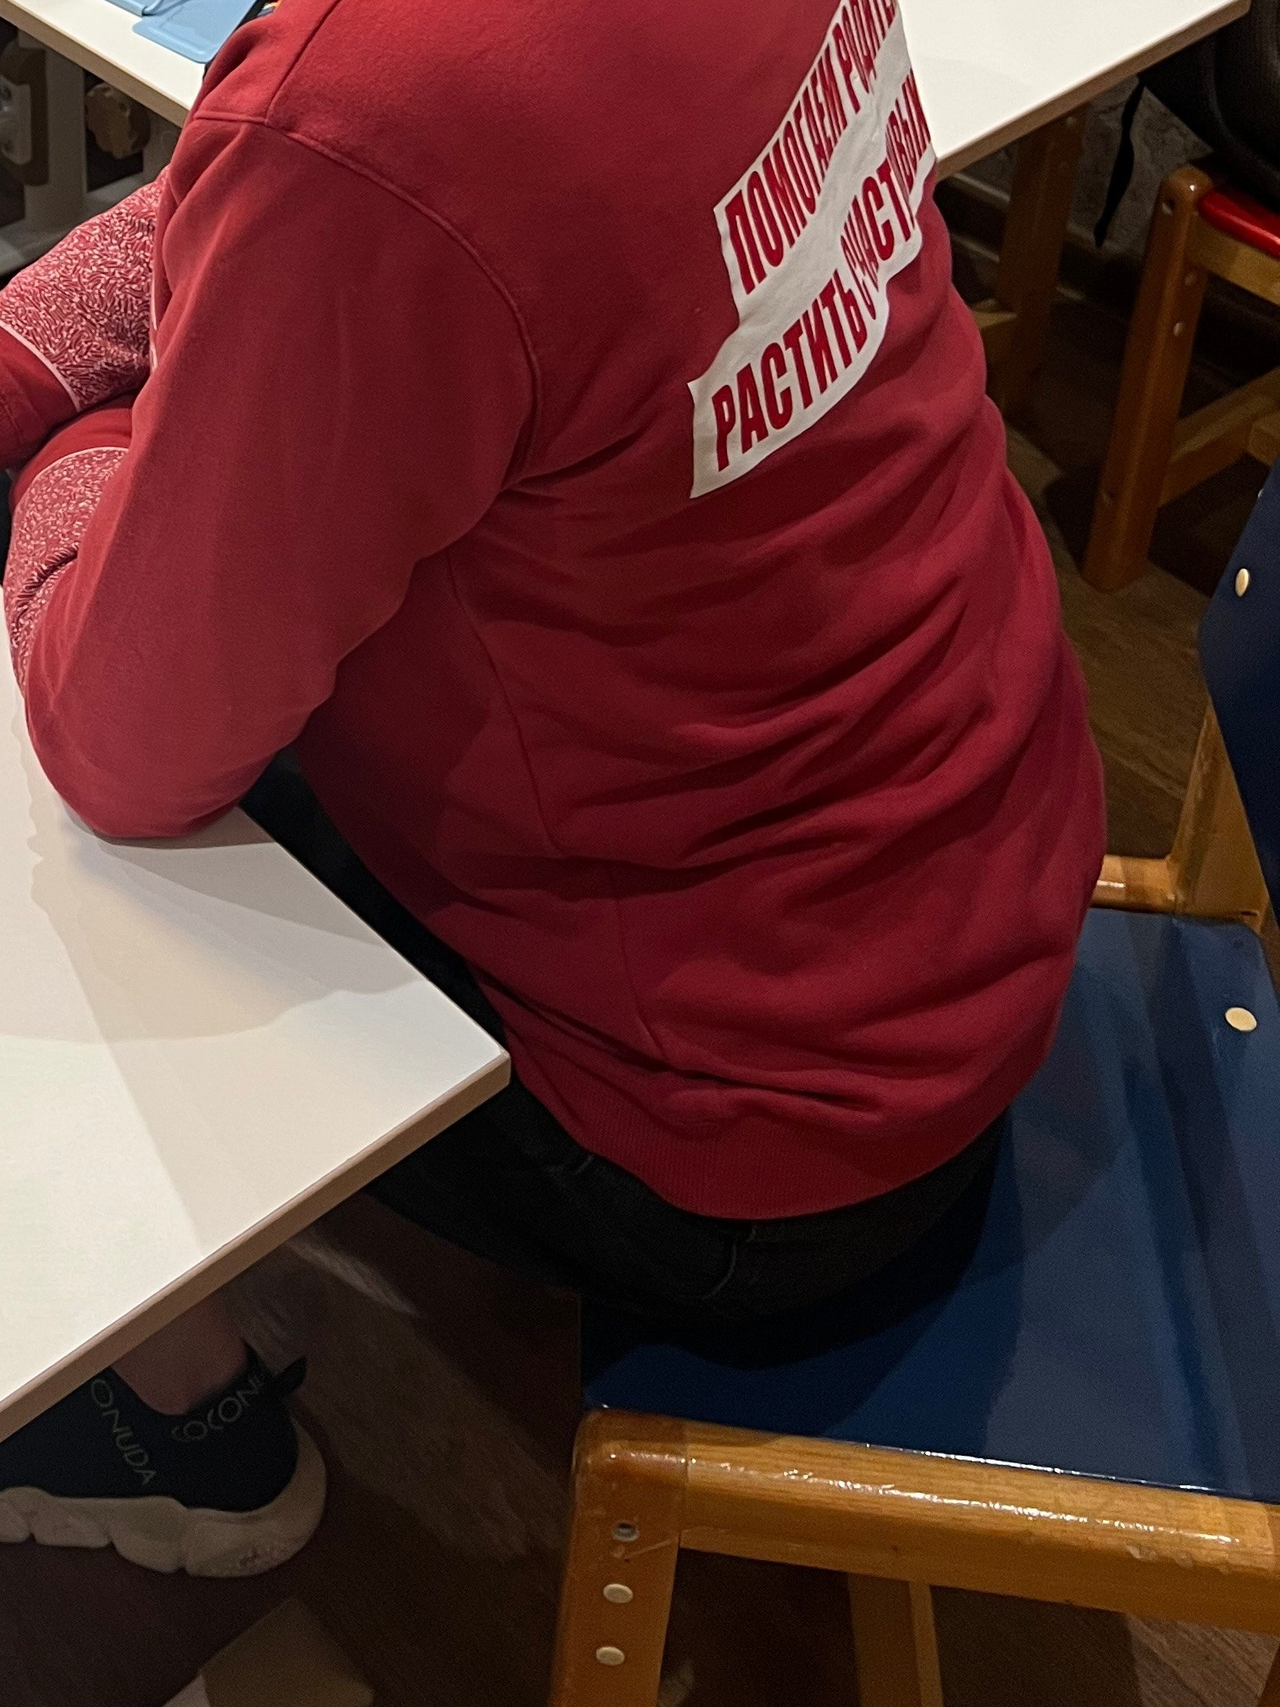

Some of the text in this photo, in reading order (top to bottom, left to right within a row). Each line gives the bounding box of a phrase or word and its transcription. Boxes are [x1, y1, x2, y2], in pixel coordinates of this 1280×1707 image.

[723, 41, 848, 295] ПОМОГАЕМ
[711, 267, 870, 473] РАСТИТЬ
[91, 1378, 156, 1486] ONUDA
